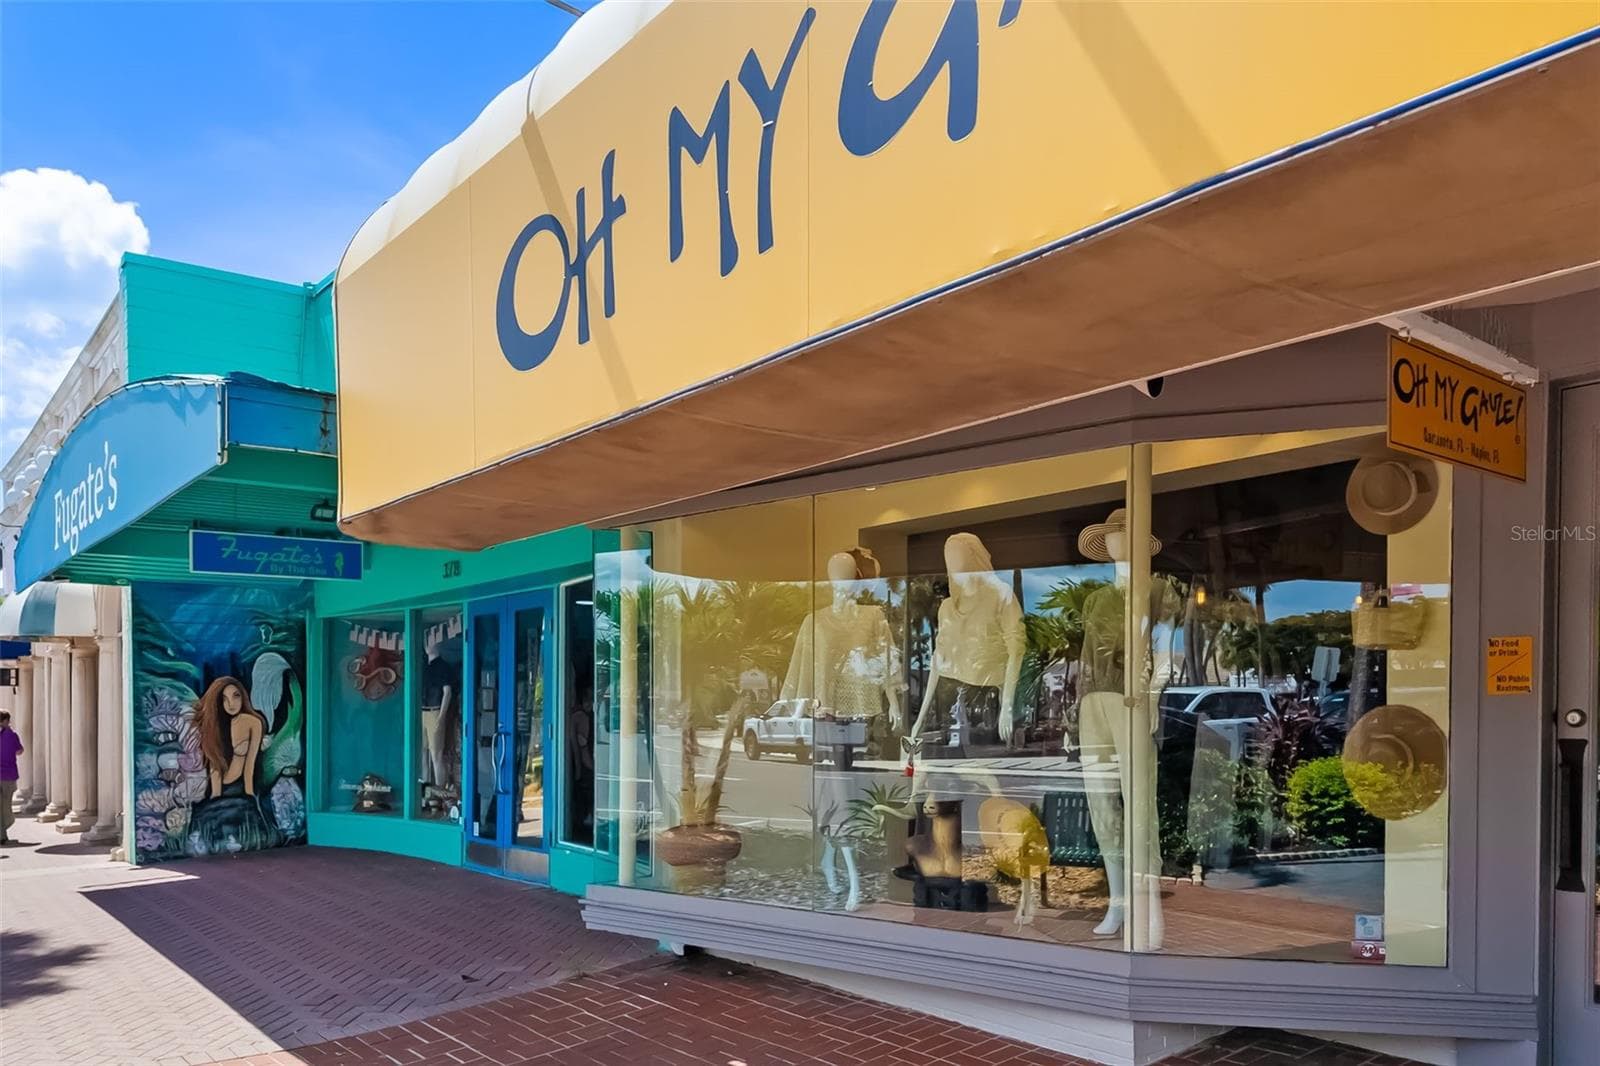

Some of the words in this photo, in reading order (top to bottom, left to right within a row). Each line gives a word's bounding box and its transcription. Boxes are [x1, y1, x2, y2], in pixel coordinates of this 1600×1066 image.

[495, 149, 627, 372] OH
[668, 6, 817, 278] MY
[837, 0, 1023, 158] G
[1392, 358, 1429, 408] OH
[1435, 370, 1460, 423] MY
[54, 441, 118, 556] Fugate's
[217, 536, 324, 573] Fugate's
[1501, 639, 1520, 648] Food
[1496, 675, 1507, 683] NO
